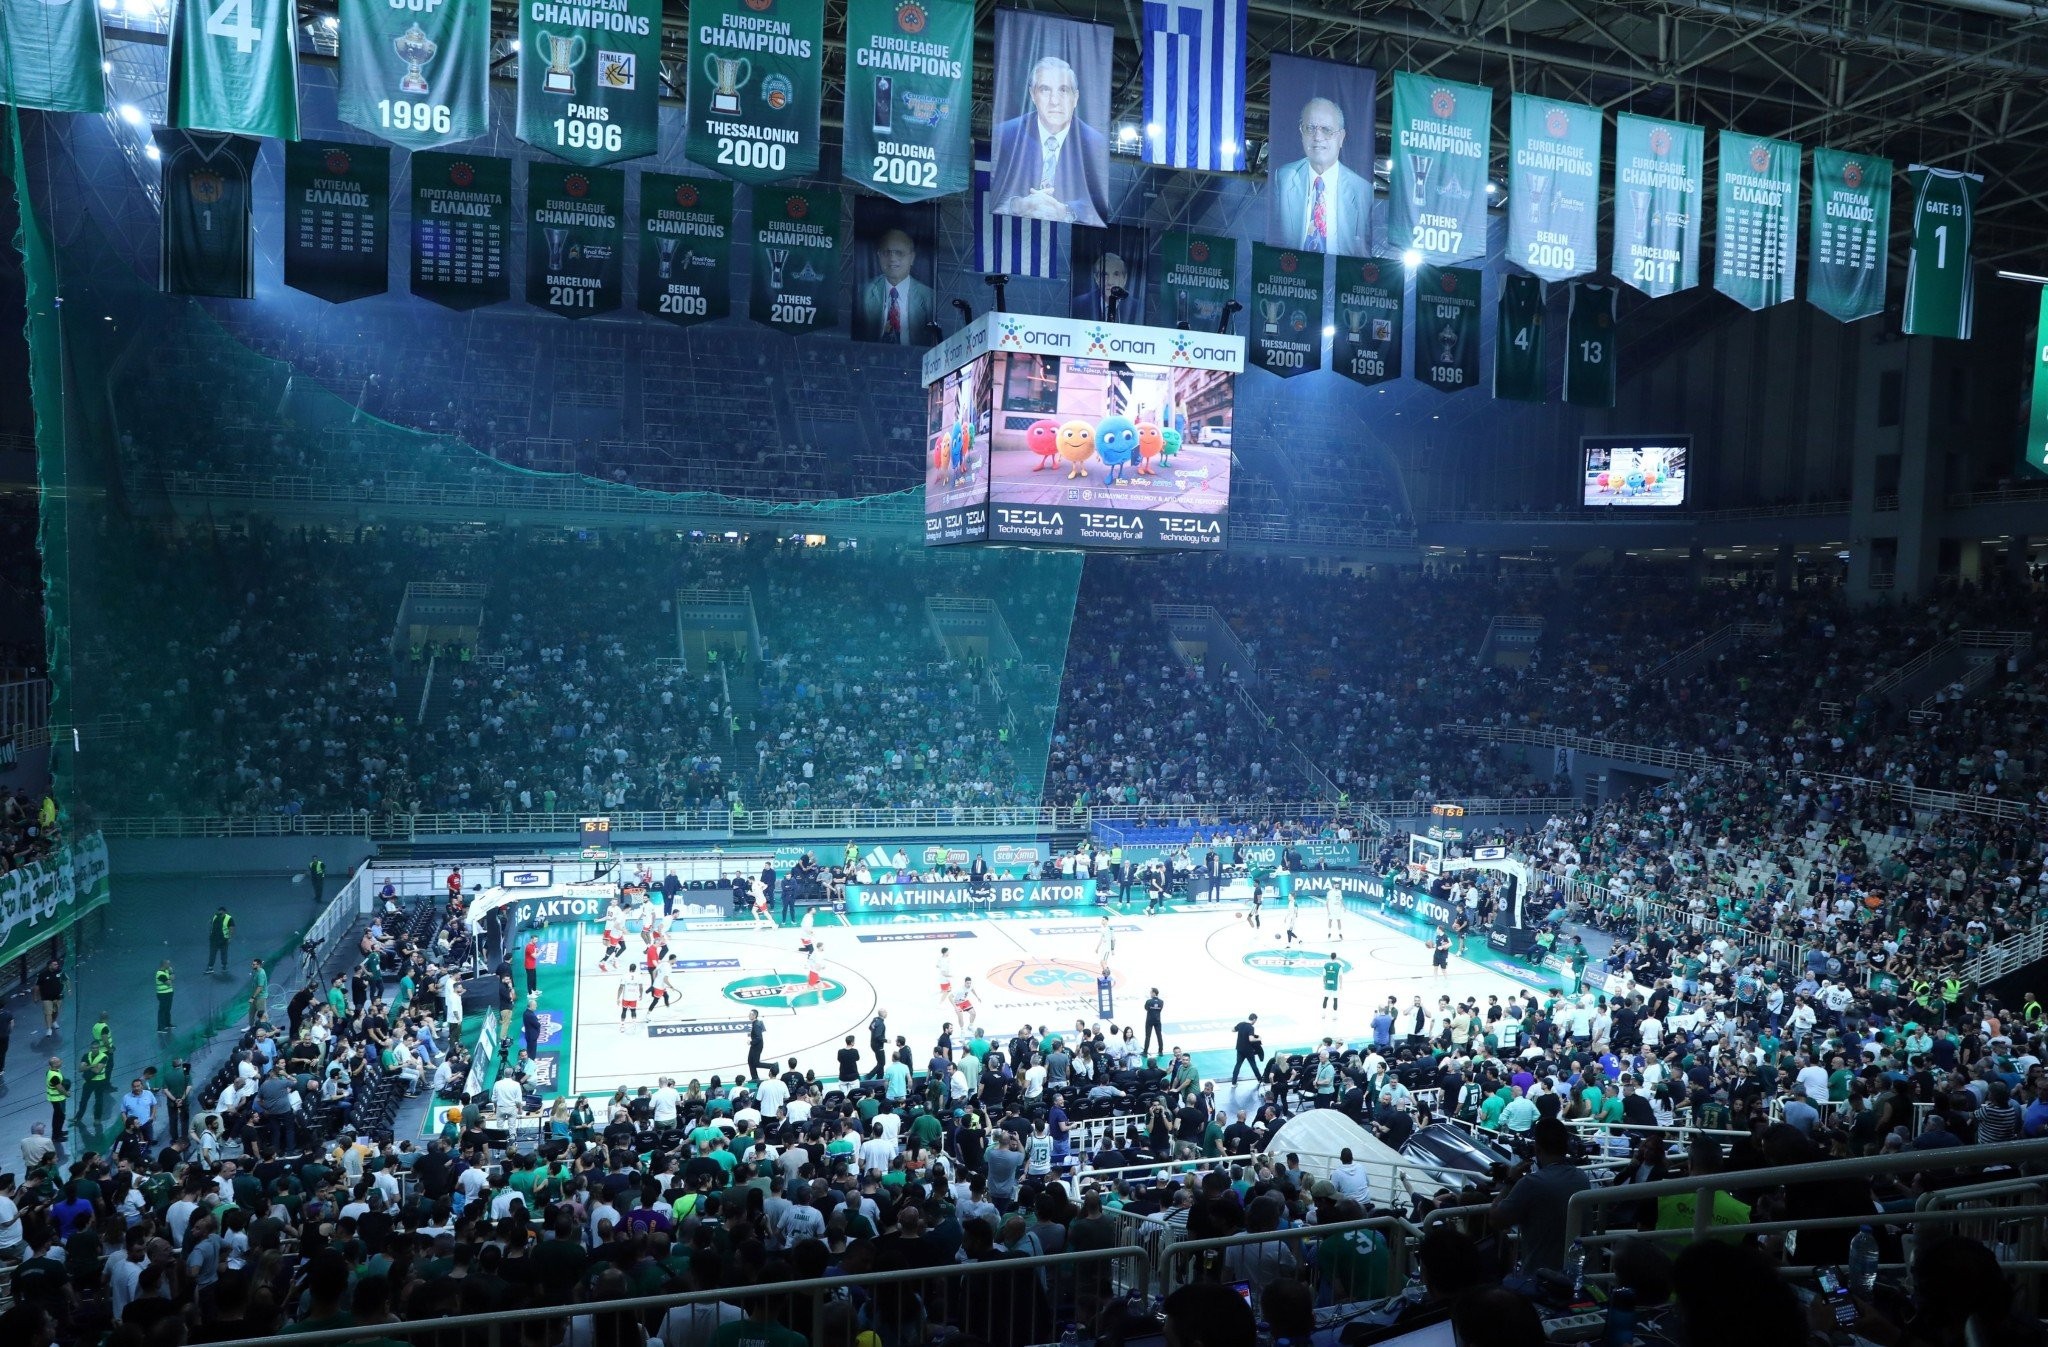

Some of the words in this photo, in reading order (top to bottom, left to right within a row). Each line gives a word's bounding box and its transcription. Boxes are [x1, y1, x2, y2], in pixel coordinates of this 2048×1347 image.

[531, 2, 650, 35] CHAMPIONS
[722, 13, 790, 35] EUROPEAN
[699, 26, 811, 58] CHAMPIONS
[870, 35, 949, 59] EUROLEAGUE
[600, 53, 622, 63] FINALE
[617, 57, 633, 84] 4
[856, 49, 961, 79] CHAMPIONS
[378, 99, 451, 134] 1996
[567, 103, 609, 121] PARIS
[553, 119, 622, 151] 1996
[706, 120, 799, 144] THESSALONIKI
[1411, 119, 1472, 140] EUROLEAGUE
[877, 141, 935, 160] BOLOGNA
[1400, 130, 1482, 158] CHAMPIONS
[1527, 139, 1584, 159] EUROLEAGUE
[717, 138, 786, 170] 2000
[1517, 150, 1592, 176] CHAMPIONS
[873, 156, 937, 188] 2002
[1632, 157, 1686, 176] EUROLEAGUE
[314, 178, 361, 192] ΚΥΠΕΛΛΑ
[1622, 168, 1694, 193] CHAMPIONS
[305, 189, 369, 207] ΕΛΛΑΔΟΣ
[420, 188, 502, 204] ΠΡΩΤΑΘΛΗΜΑΤΑ
[1733, 186, 1782, 207] ΕΛΛΑΔΟΣ
[1833, 190, 1869, 206] ΚΥΠΕΛΛΑ
[430, 201, 492, 217] ΕΛΛΑΔΟΣ
[546, 200, 605, 214] EUROLEAGUE
[1826, 201, 1874, 222] ΕΛΛΑΔΟΣ
[1927, 201, 1948, 215] GATE
[1952, 204, 1962, 217] 13
[203, 210, 211, 230] 1
[535, 210, 615, 229] CHAMPIONS
[657, 209, 715, 224] EUROLEAGUE
[1419, 214, 1457, 229] ATHENS
[647, 219, 724, 238] CHAMPIONS
[768, 221, 824, 235] EUROLEAGUE
[758, 230, 833, 249] CHAMPIONS
[1412, 226, 1463, 254] 2007
[1536, 230, 1568, 246] BERLIN
[1934, 226, 1947, 268] 1
[1528, 243, 1575, 270] 2009
[1631, 244, 1680, 262] BARCELONA
[1175, 264, 1222, 276] EUROLEAGUE
[1634, 258, 1675, 284] 2011
[546, 275, 601, 288] BARCELONA
[668, 284, 700, 295] BERLIN
[1167, 272, 1229, 290] CHAMPIONS
[1269, 275, 1306, 287] EUROPEAN
[549, 287, 594, 308] 2011
[777, 293, 811, 305] ATHENS
[1257, 283, 1317, 300] CHAMPIONS
[1352, 285, 1388, 296] EUROPEAN
[659, 294, 706, 316] 2009
[1341, 293, 1398, 310] CHAMPIONS
[1421, 294, 1475, 307] INTERCONTINENTAL
[770, 304, 817, 325] 2007
[1436, 306, 1460, 320] CUP
[1261, 339, 1311, 352] THESSALONIKI
[1514, 328, 1528, 350] 4
[1266, 349, 1304, 369] 2000
[1357, 349, 1378, 359] PARIS
[1580, 340, 1602, 364] 13
[1351, 359, 1385, 377] 1996
[1431, 366, 1463, 384] 1996
[997, 509, 1064, 525] TESLA
[1079, 514, 1144, 529] TESLA
[1159, 517, 1220, 533] TESLA
[998, 525, 1041, 536] Technology
[1042, 526, 1053, 535] for
[1054, 527, 1063, 536] all
[1080, 529, 1121, 540] Technology
[1123, 530, 1133, 538] for
[1135, 531, 1143, 540] all
[1160, 533, 1199, 544] Technology
[1201, 534, 1211, 542] for
[1212, 535, 1220, 543] all
[1306, 846, 1350, 855] TESLA
[1002, 887, 1024, 901] BC
[1029, 886, 1084, 901] AKTOR
[536, 899, 599, 917] AKTOR
[893, 909, 1073, 922] ATHENS
[1399, 893, 1414, 909] BC
[1415, 900, 1449, 923] AKTOR
[1831, 996, 1842, 1005] 93
[656, 1023, 753, 1035] PORTOBELLO'S
[1609, 1056, 1619, 1068] 3
[1036, 1148, 1047, 1160] 13
